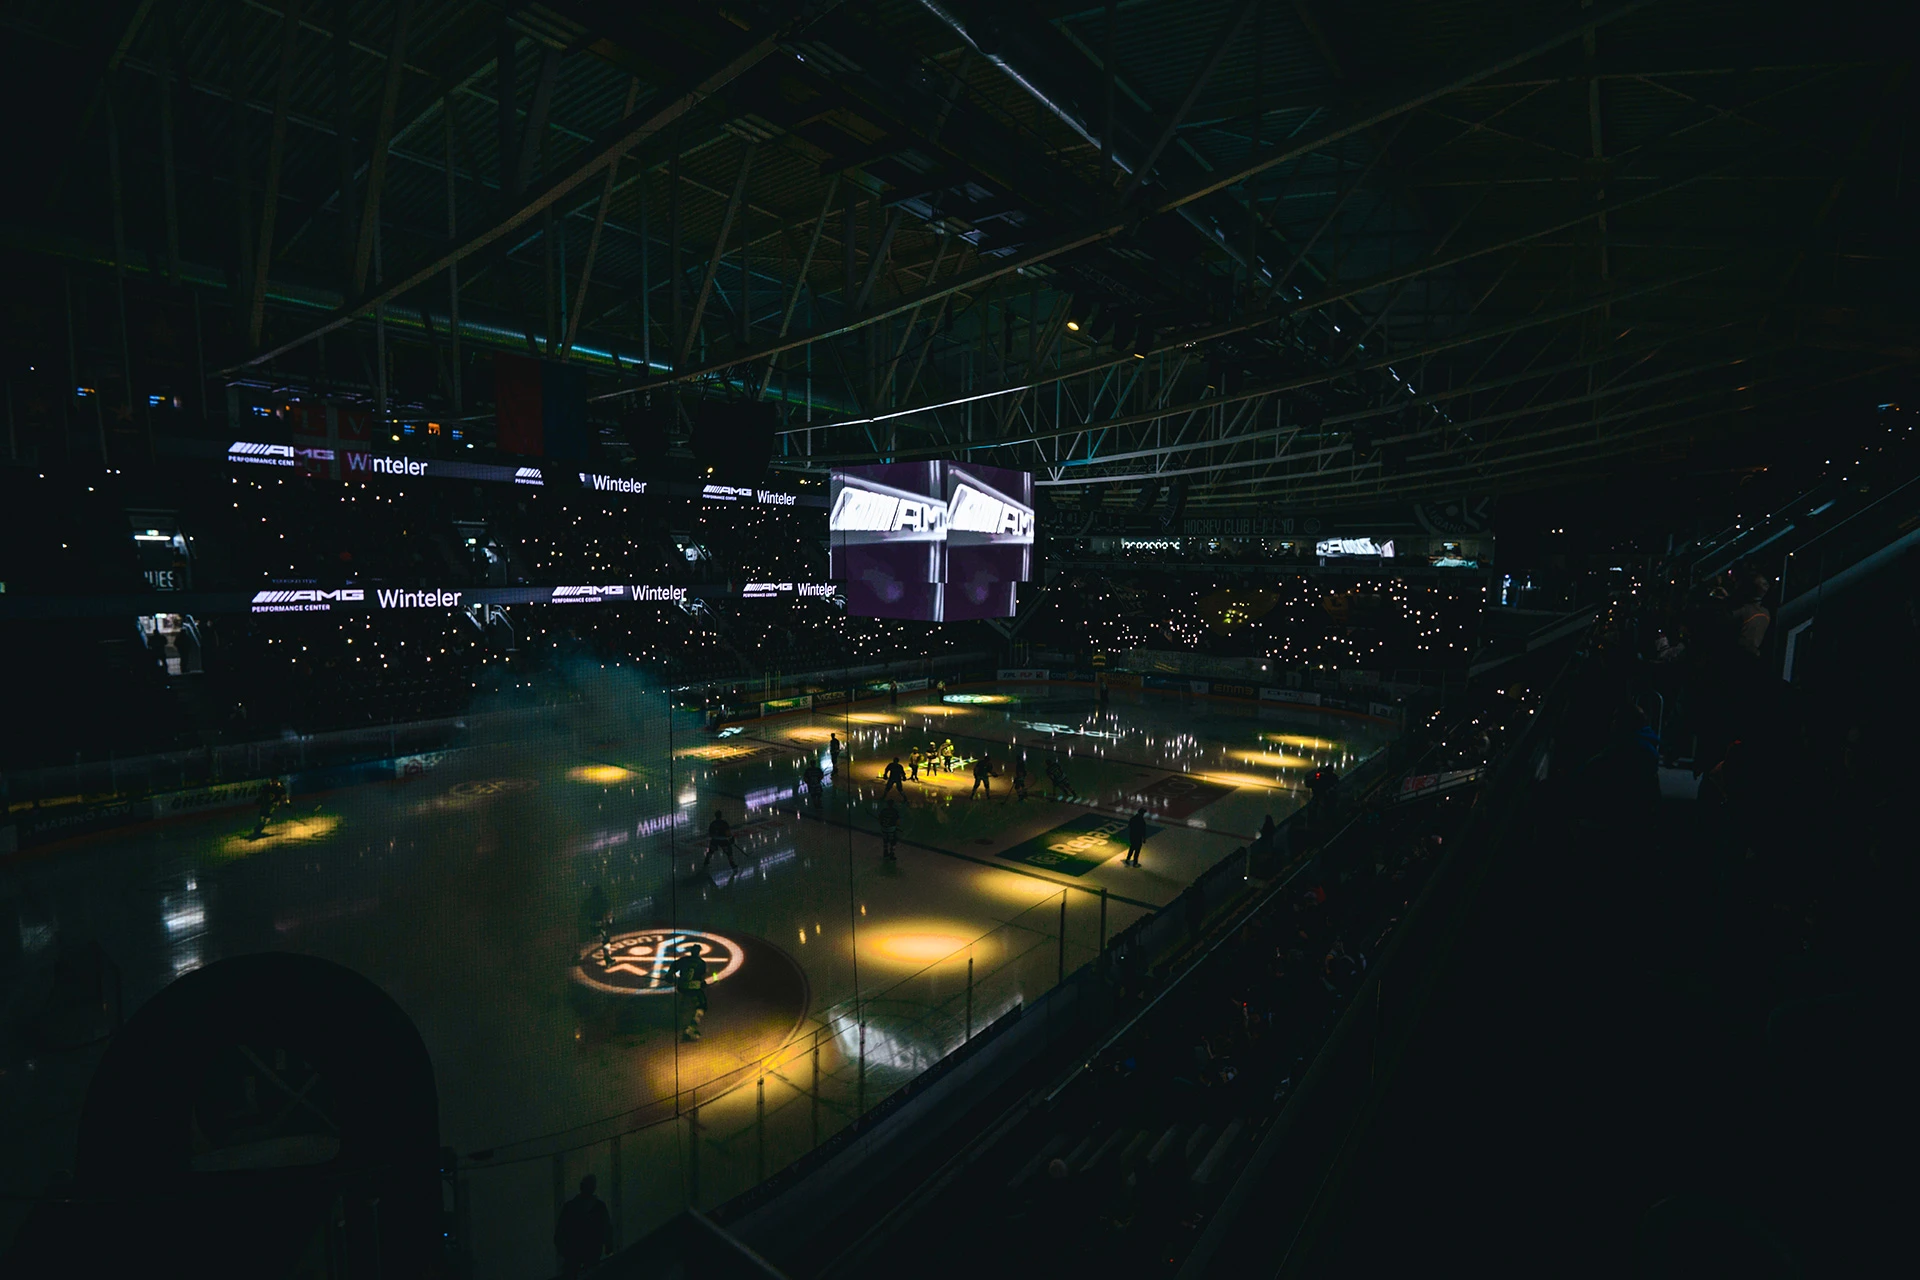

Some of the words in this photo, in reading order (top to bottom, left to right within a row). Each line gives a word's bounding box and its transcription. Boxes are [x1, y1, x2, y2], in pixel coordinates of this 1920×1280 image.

[228, 455, 277, 466] PERFORMANCE
[347, 451, 428, 477] Winteler
[591, 473, 647, 495] Winteler
[719, 486, 752, 497] AMG
[756, 489, 796, 506] Winteler
[1184, 518, 1221, 534] HOCKEY
[1224, 518, 1249, 534] CLUB
[1425, 505, 1468, 534] LUGANO
[289, 589, 365, 602] AMG
[377, 587, 462, 609] Winteler
[577, 585, 624, 596] AMG
[632, 584, 687, 601] Winteler
[758, 582, 793, 592] AMG
[798, 582, 837, 597] Winteler
[251, 604, 303, 613] PERFORMANCE
[304, 603, 331, 611] CENTER
[34, 812, 96, 834] MARINO
